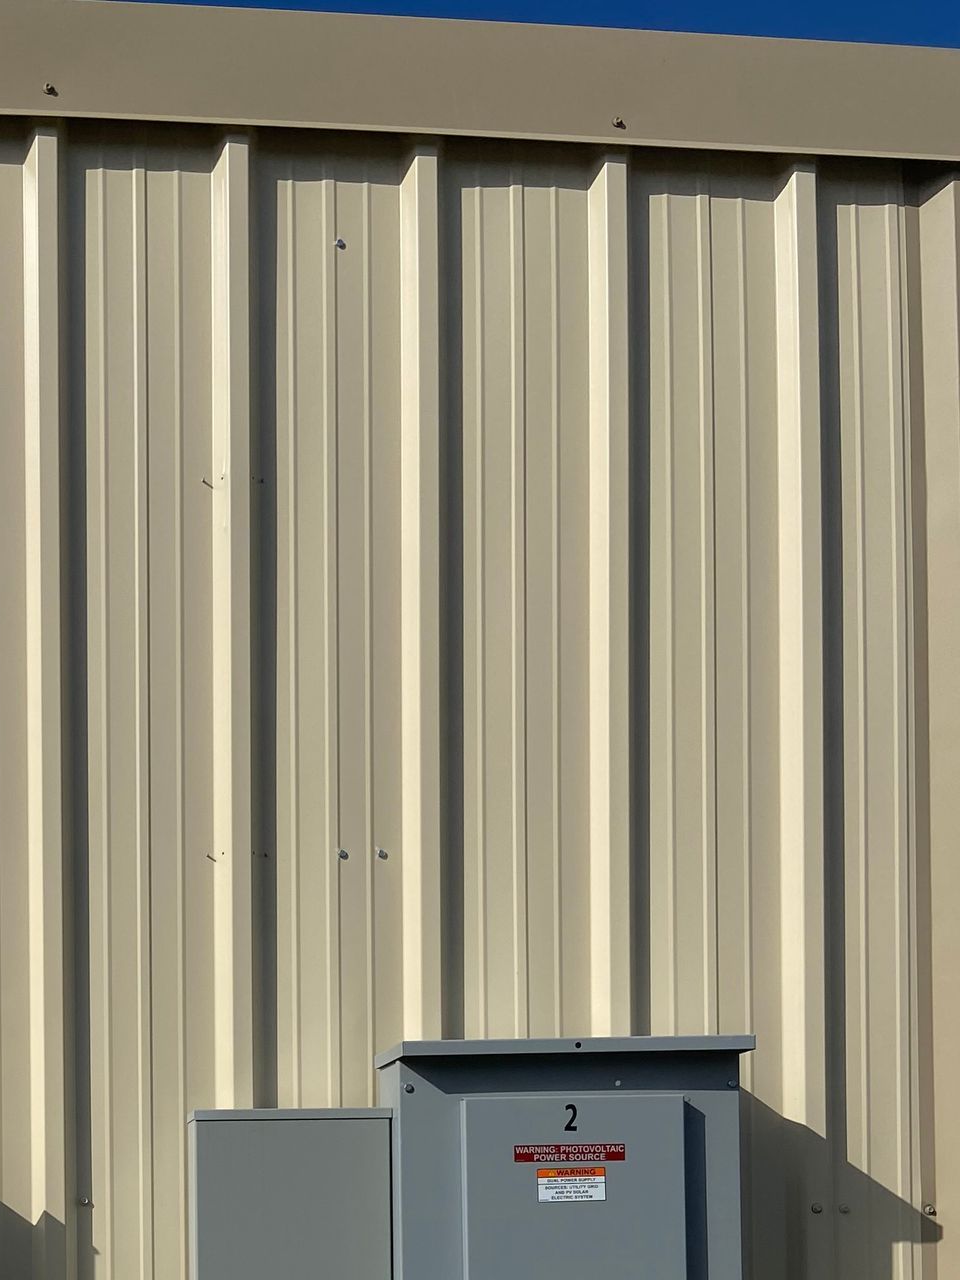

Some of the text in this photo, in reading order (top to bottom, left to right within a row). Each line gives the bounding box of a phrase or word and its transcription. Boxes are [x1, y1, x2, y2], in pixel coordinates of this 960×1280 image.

[564, 1104, 578, 1131] 2
[516, 1145, 624, 1154] WARNING: PHOTOVOLTAIC
